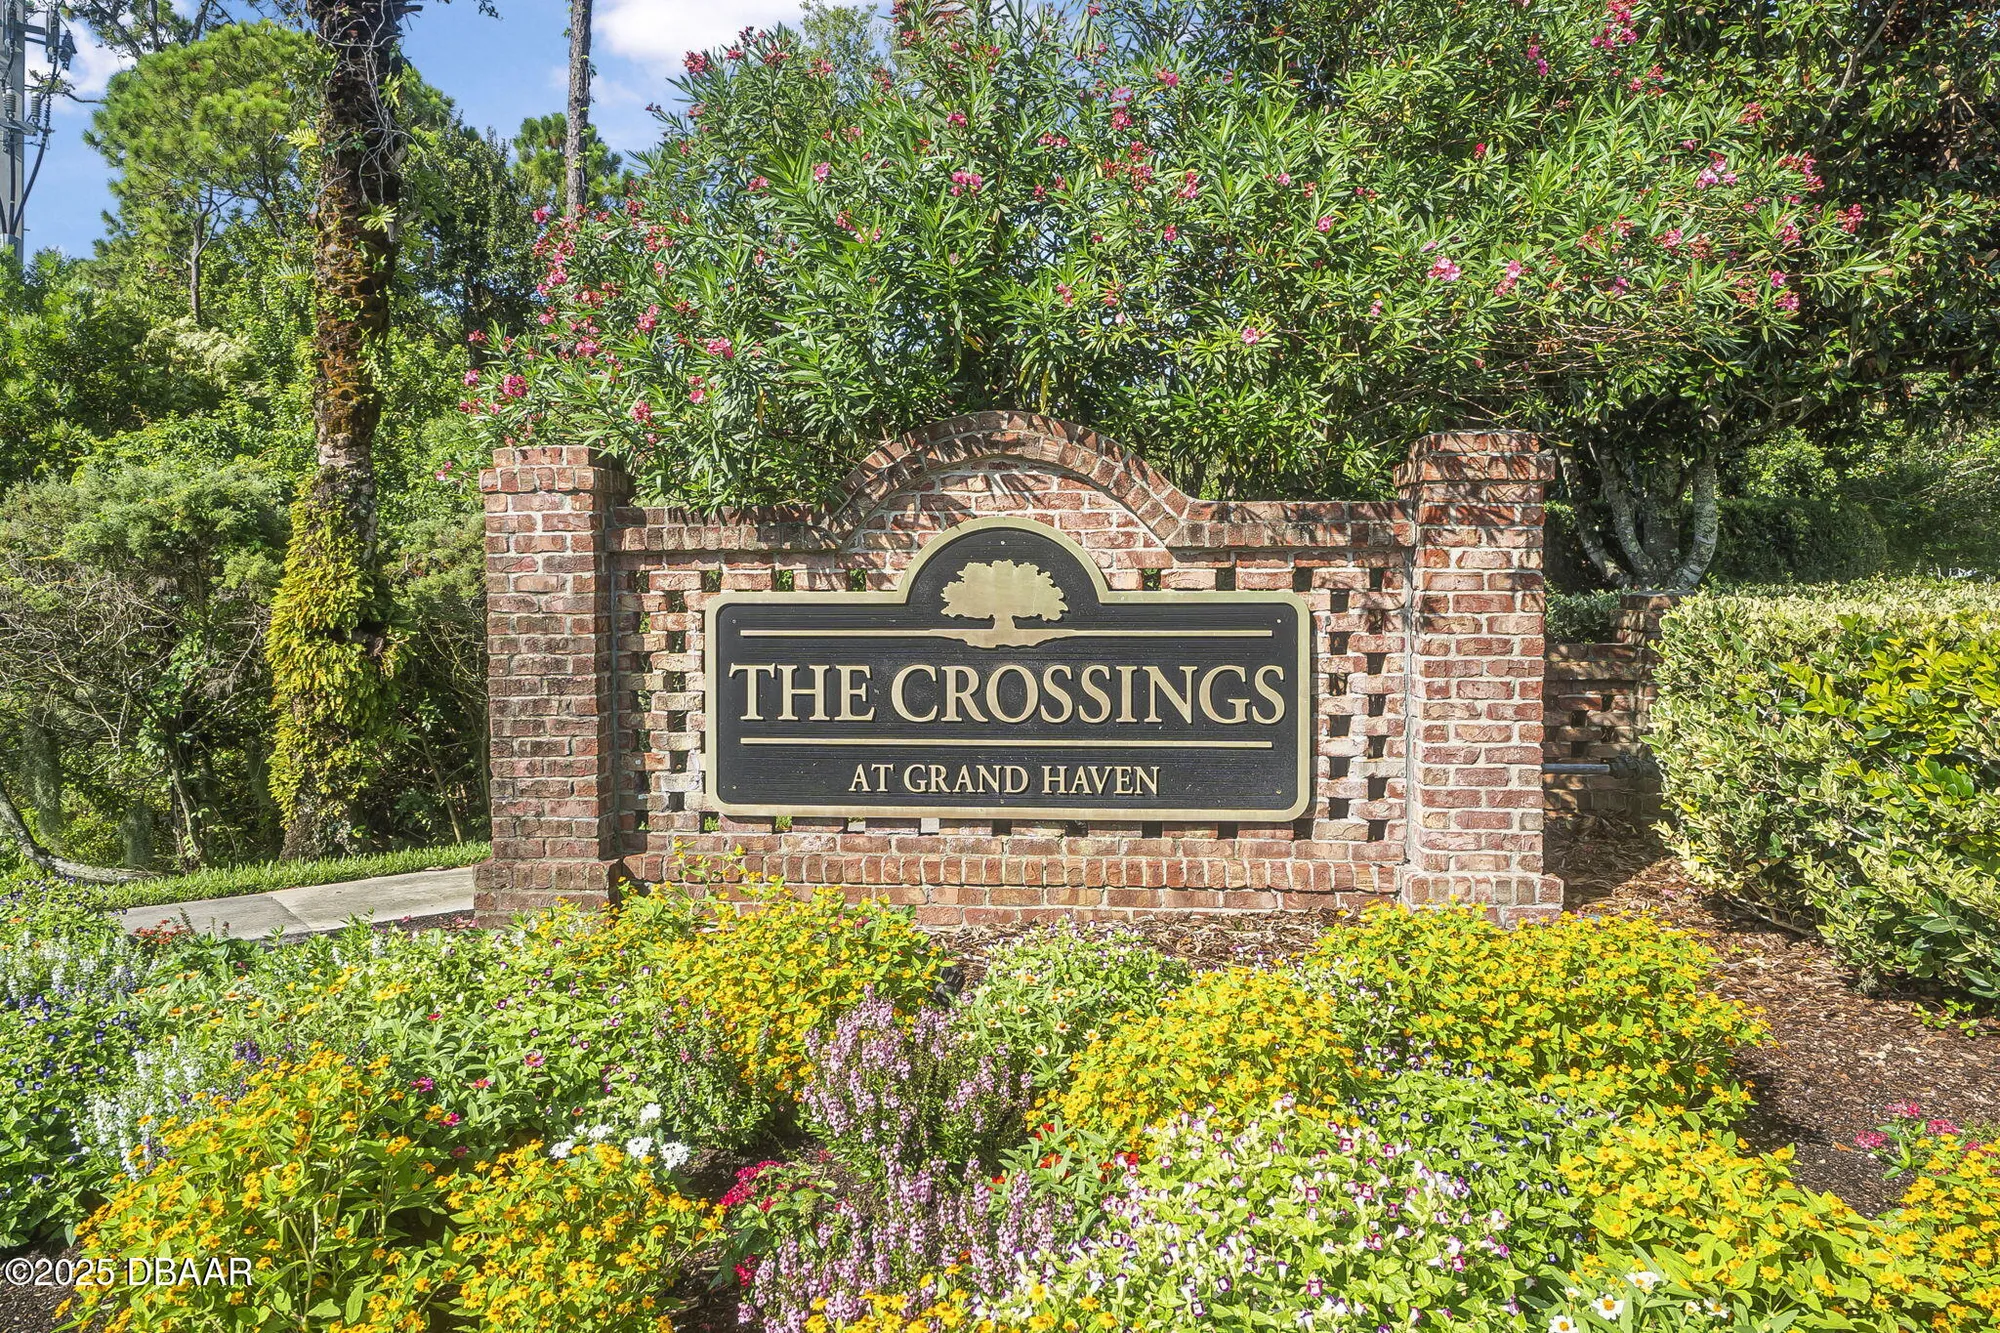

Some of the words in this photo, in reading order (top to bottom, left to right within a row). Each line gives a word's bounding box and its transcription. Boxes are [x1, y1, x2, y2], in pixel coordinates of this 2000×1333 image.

[729, 663, 876, 723] THE
[890, 664, 1286, 726] CROSSINGS
[849, 763, 894, 794] AT
[903, 763, 1029, 795] GRAND
[1042, 765, 1160, 796] HAVEN
